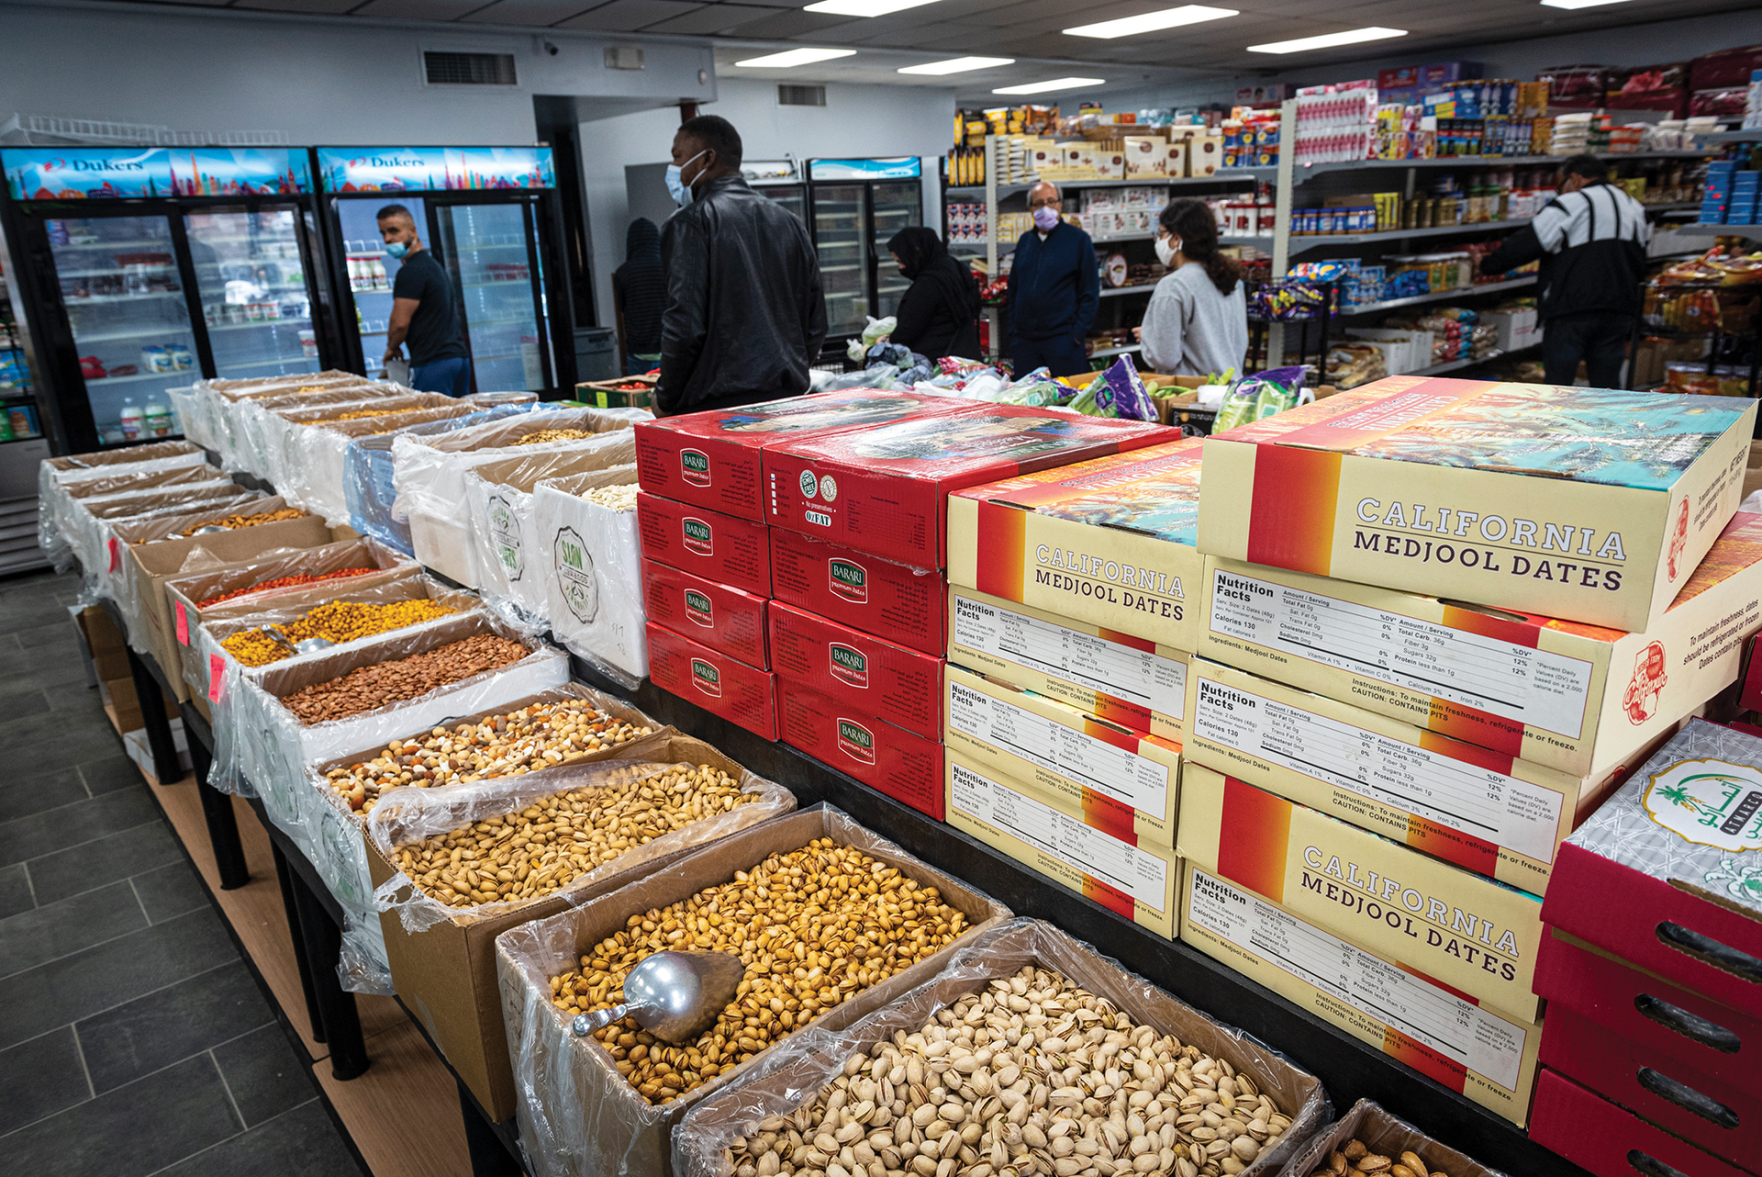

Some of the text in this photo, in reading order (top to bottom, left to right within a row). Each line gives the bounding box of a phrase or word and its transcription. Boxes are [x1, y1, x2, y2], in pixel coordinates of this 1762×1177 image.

[72, 159, 144, 172] Dukers
[371, 156, 424, 168] Dukers
[684, 454, 706, 469] BARARI
[686, 524, 708, 538] BARARI
[1357, 498, 1626, 560] CALIFORNIA
[1036, 544, 1184, 598] CALIFORNIA
[1354, 531, 1623, 591] MEDJOOL DATES
[834, 564, 862, 584] BARARI
[1036, 569, 1184, 620] MEDJOOL DATES
[1216, 584, 1251, 602] Facts
[1217, 574, 1274, 598] Nutrition
[688, 594, 708, 611] BARARI
[957, 598, 994, 617] Nutrition
[1282, 598, 1296, 606] Total
[1283, 589, 1304, 600] Amount
[1308, 596, 1329, 607] Serving
[957, 606, 979, 620] Facts
[1214, 612, 1255, 630] Calories 130
[1288, 616, 1302, 625] Trans
[1690, 636, 1696, 646] To
[1697, 622, 1719, 642] maintain
[1746, 600, 1759, 613] dates
[1279, 622, 1310, 635] Cholesterol
[1311, 631, 1322, 639] 0mg
[1279, 631, 1299, 640] Sodium
[1299, 636, 1311, 645] 0mg
[1399, 619, 1423, 630] Amount
[1428, 626, 1453, 638] Serving
[1683, 612, 1760, 665] should be refrigerated or frozen
[1208, 634, 1287, 663] Ingredients: Medjool Dates
[1398, 628, 1527, 666] Total Carb. 36g 12%
[1403, 647, 1436, 662] Sugars 32g
[1404, 639, 1419, 647] Fiber
[1511, 667, 1526, 676] 12%
[1699, 654, 1713, 669] Dates
[1714, 643, 1732, 661] contain
[834, 649, 862, 668] BARARI
[1394, 654, 1416, 665] Protein
[1418, 661, 1430, 669] less
[1431, 664, 1445, 673] than
[694, 664, 716, 680] BARARI
[1307, 650, 1326, 661] Vitamin
[1354, 664, 1375, 675] Vitamin
[1407, 680, 1431, 692] Calcium
[1460, 695, 1472, 704] Iron
[952, 684, 986, 705] Nutrition
[952, 692, 973, 707] Facts
[1200, 691, 1233, 710] Facts
[1201, 681, 1255, 708] Nutrition
[1351, 686, 1448, 721] CAUTION: CONTAINS PITS
[1352, 678, 1578, 752] Instructions: To maintain freshness, refrigerate or freeze.
[842, 725, 870, 746] BARARI
[1198, 718, 1238, 737] Calories 130
[1192, 738, 1269, 771] Ingredients: Medjool Dates
[954, 766, 986, 788] Nutrition
[954, 773, 974, 789] Facts
[1331, 797, 1425, 837] CAUTION: CONTAINS PITS
[1725, 793, 1762, 833] ATMARCO
[1332, 790, 1550, 876] Instructions: To maintain freshness, refrigerate or freeze.
[1195, 881, 1226, 904] Facts
[1196, 872, 1247, 905] Nutrition
[1304, 846, 1519, 957] CALIFORNIA
[1301, 872, 1516, 981] MEDJOOL DATES
[1316, 999, 1401, 1049] CAUTION: CONTAINS PITS
